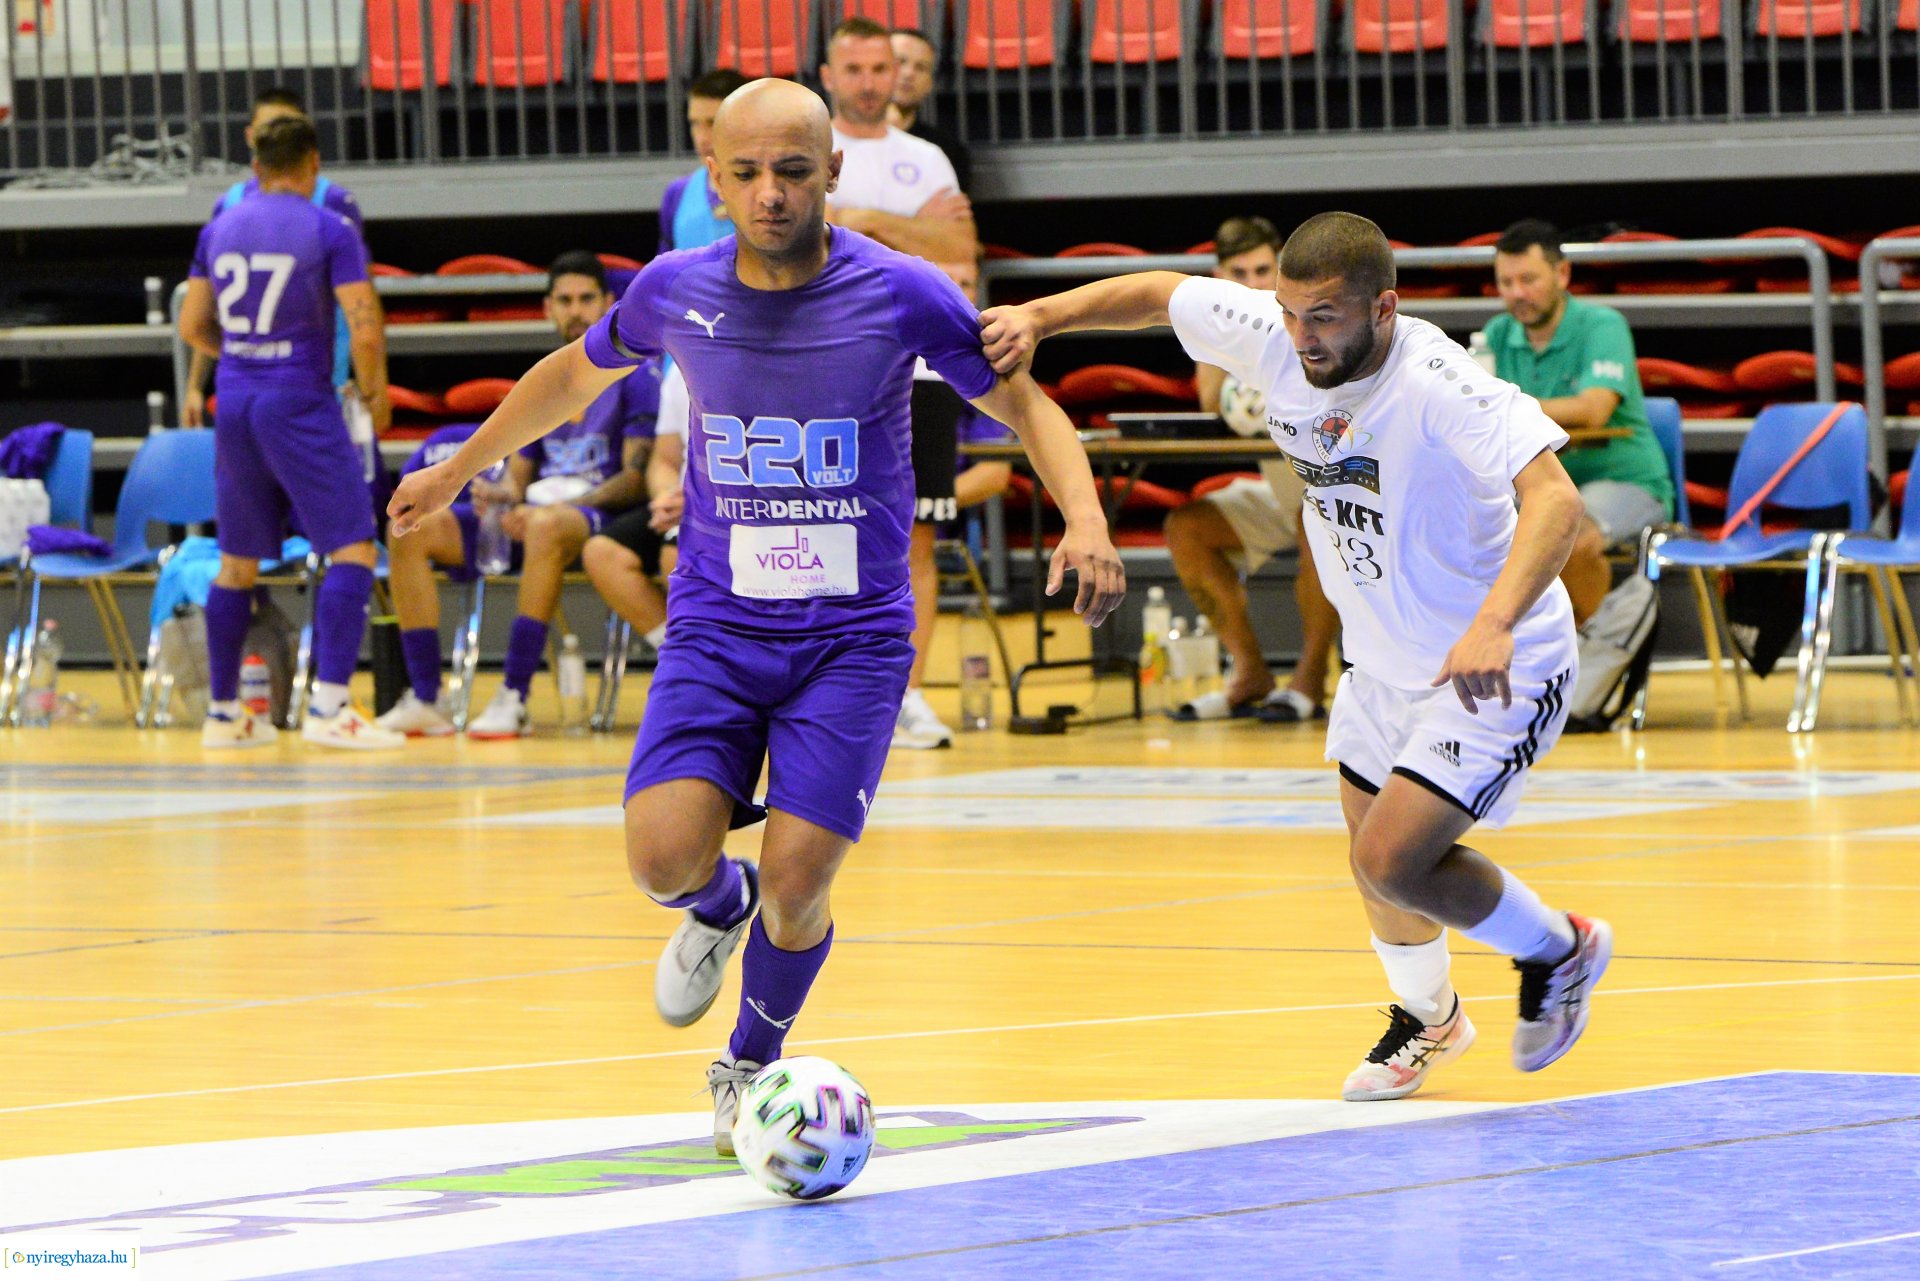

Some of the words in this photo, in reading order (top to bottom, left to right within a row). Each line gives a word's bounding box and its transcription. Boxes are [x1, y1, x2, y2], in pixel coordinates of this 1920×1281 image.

[214, 252, 296, 335] 27
[702, 413, 859, 488] 220
[812, 469, 852, 485] VOLT
[715, 496, 868, 520] INTERDENTAL
[1335, 498, 1384, 535] KFT
[756, 553, 824, 570] VIOLA
[790, 574, 826, 584] HOME
[743, 584, 848, 597] www.violahome.hu
